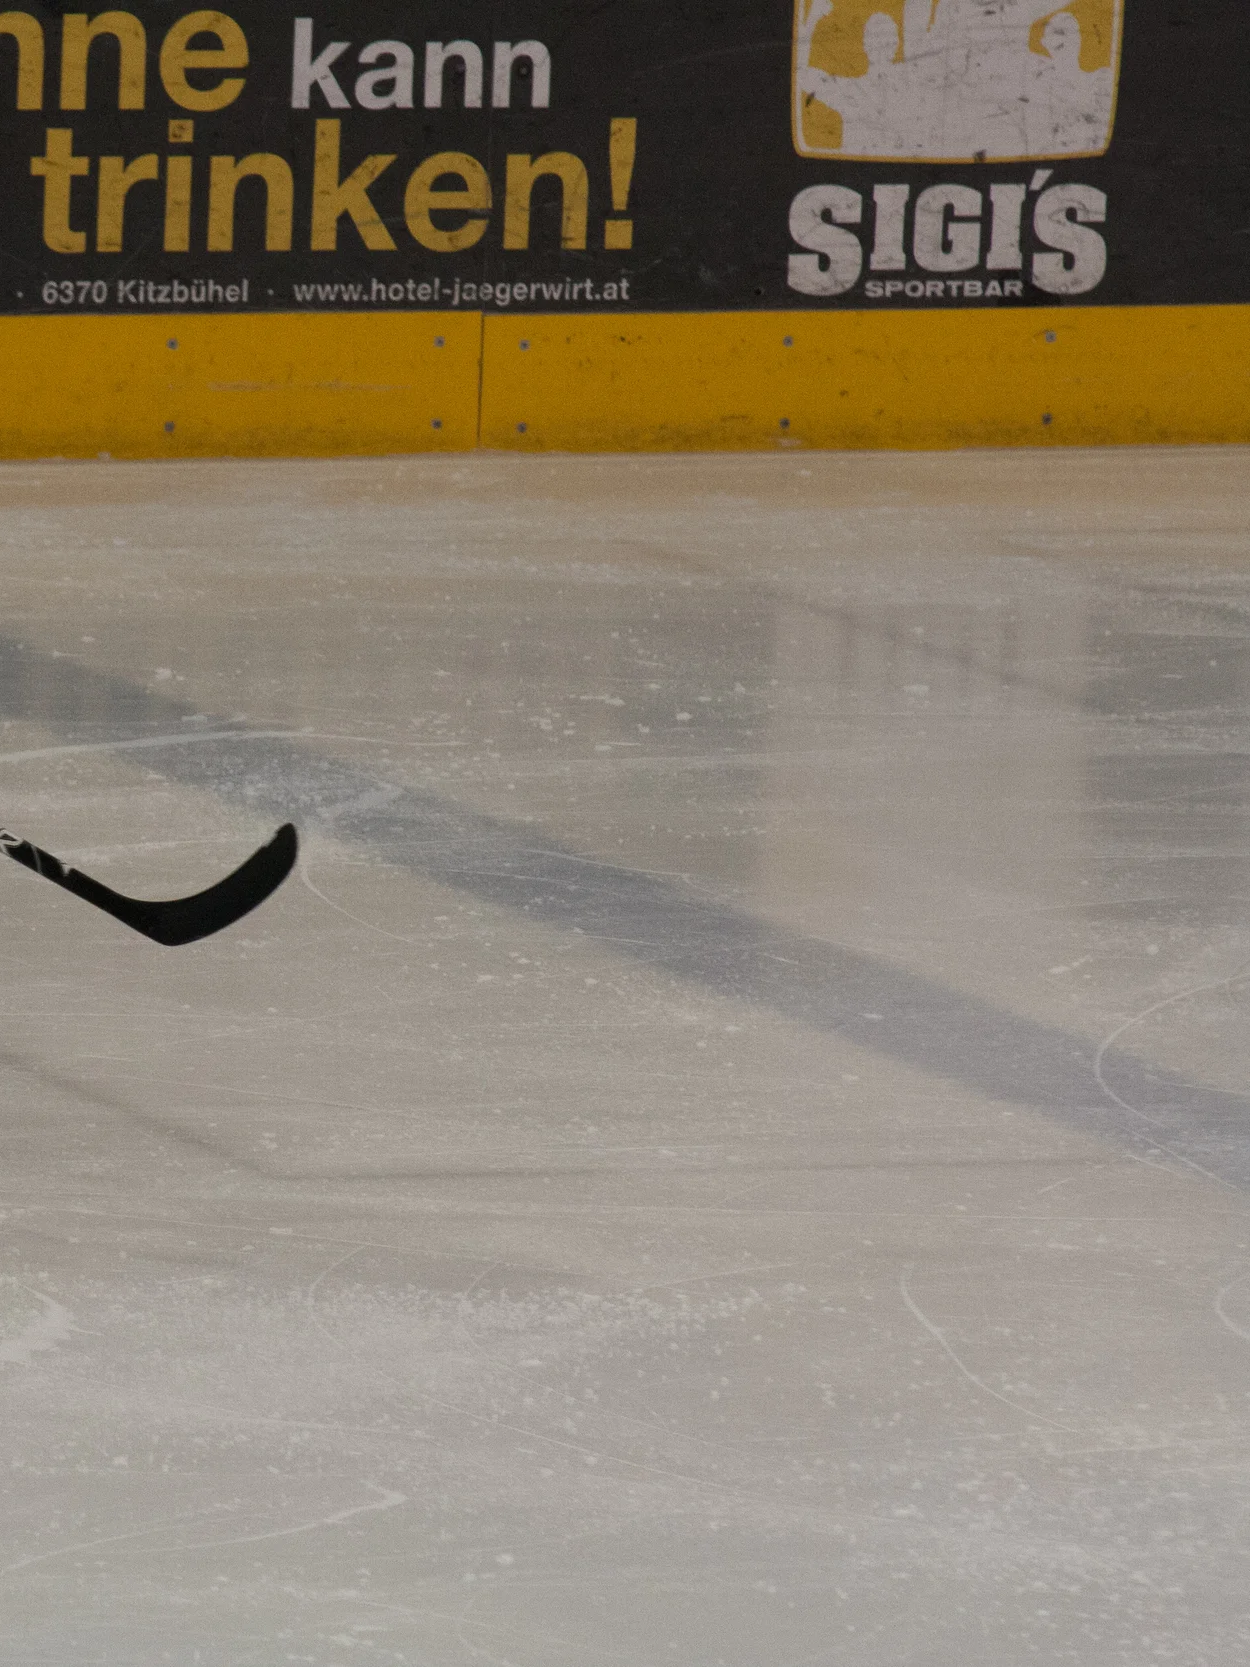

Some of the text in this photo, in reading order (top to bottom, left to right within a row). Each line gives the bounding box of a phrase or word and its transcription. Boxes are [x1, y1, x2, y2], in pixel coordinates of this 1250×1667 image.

[290, 17, 551, 109] kann
[30, 117, 637, 253] trinken!
[42, 280, 108, 304] 6370
[117, 278, 249, 304] Kitzbühel
[294, 276, 630, 305] www.hotel-jaegerwirt.at
[864, 280, 1024, 297] SPORTBAR
